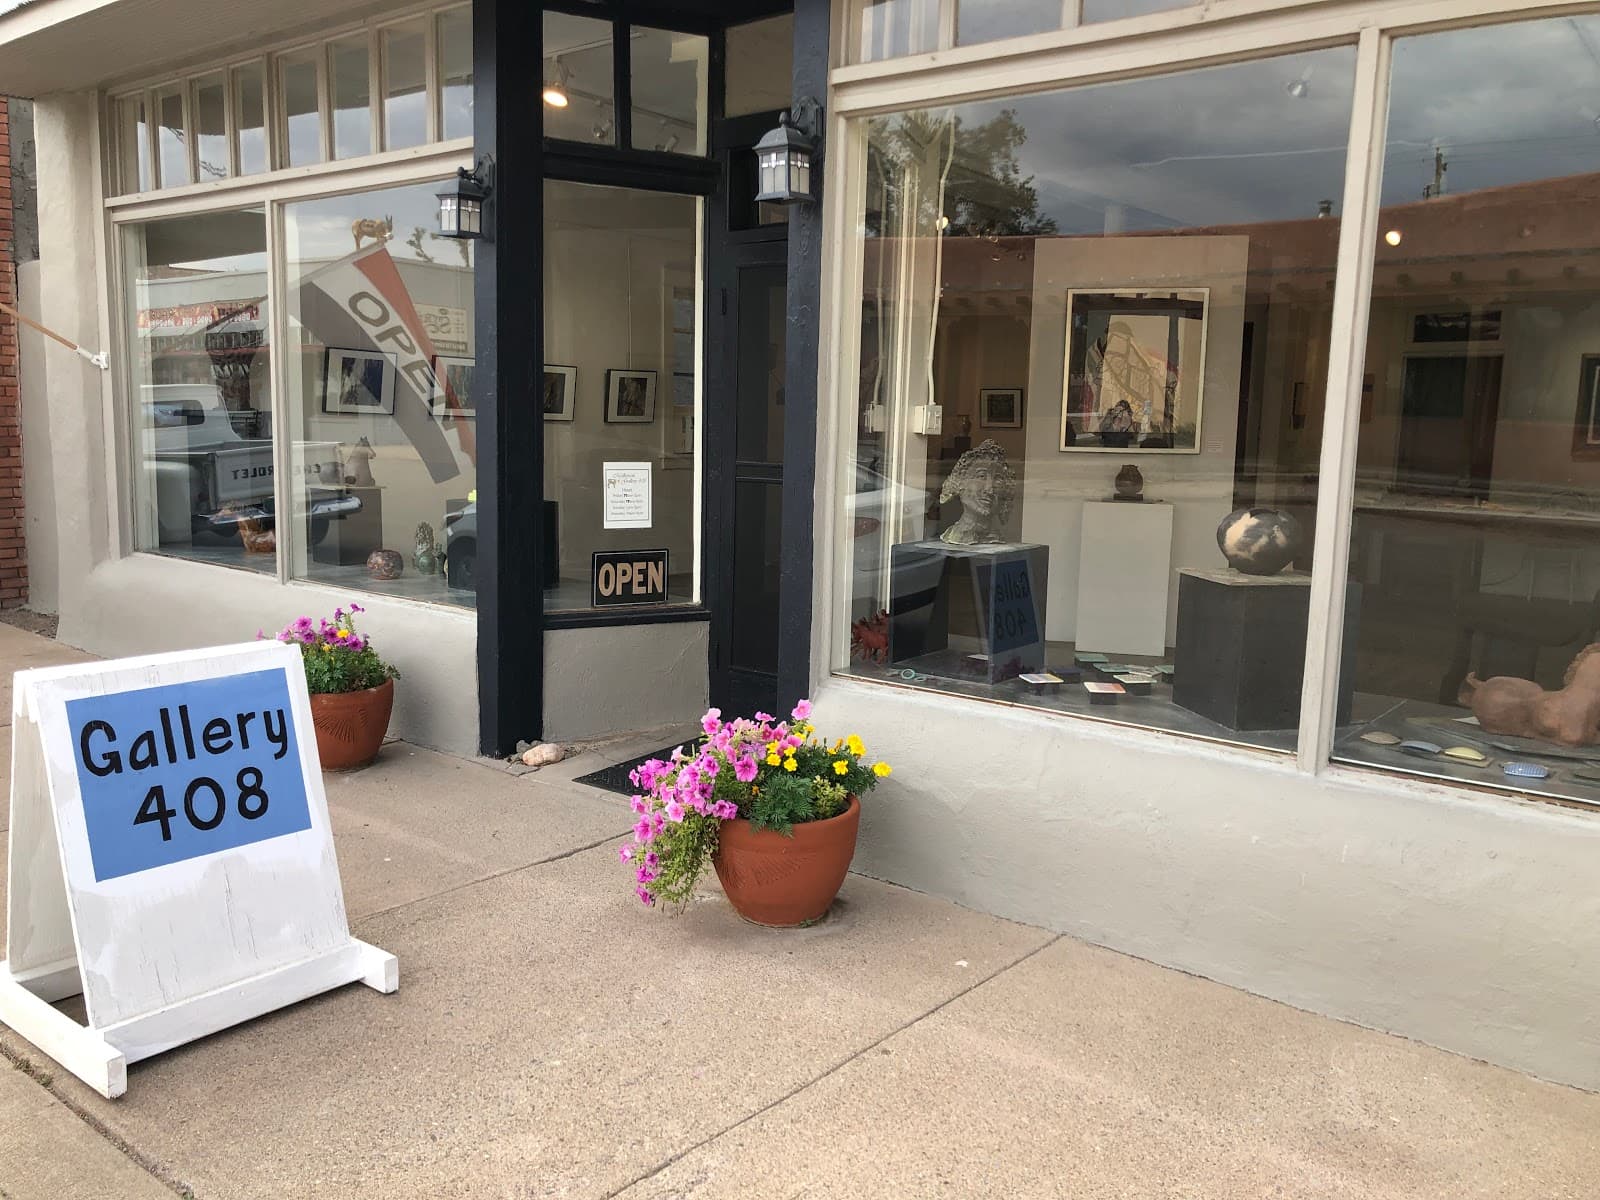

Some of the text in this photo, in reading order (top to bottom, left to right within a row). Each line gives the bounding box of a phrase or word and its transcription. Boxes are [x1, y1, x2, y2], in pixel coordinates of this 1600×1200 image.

[598, 561, 663, 597] OPEN
[81, 704, 288, 776] Gallery
[133, 766, 269, 841] 408
